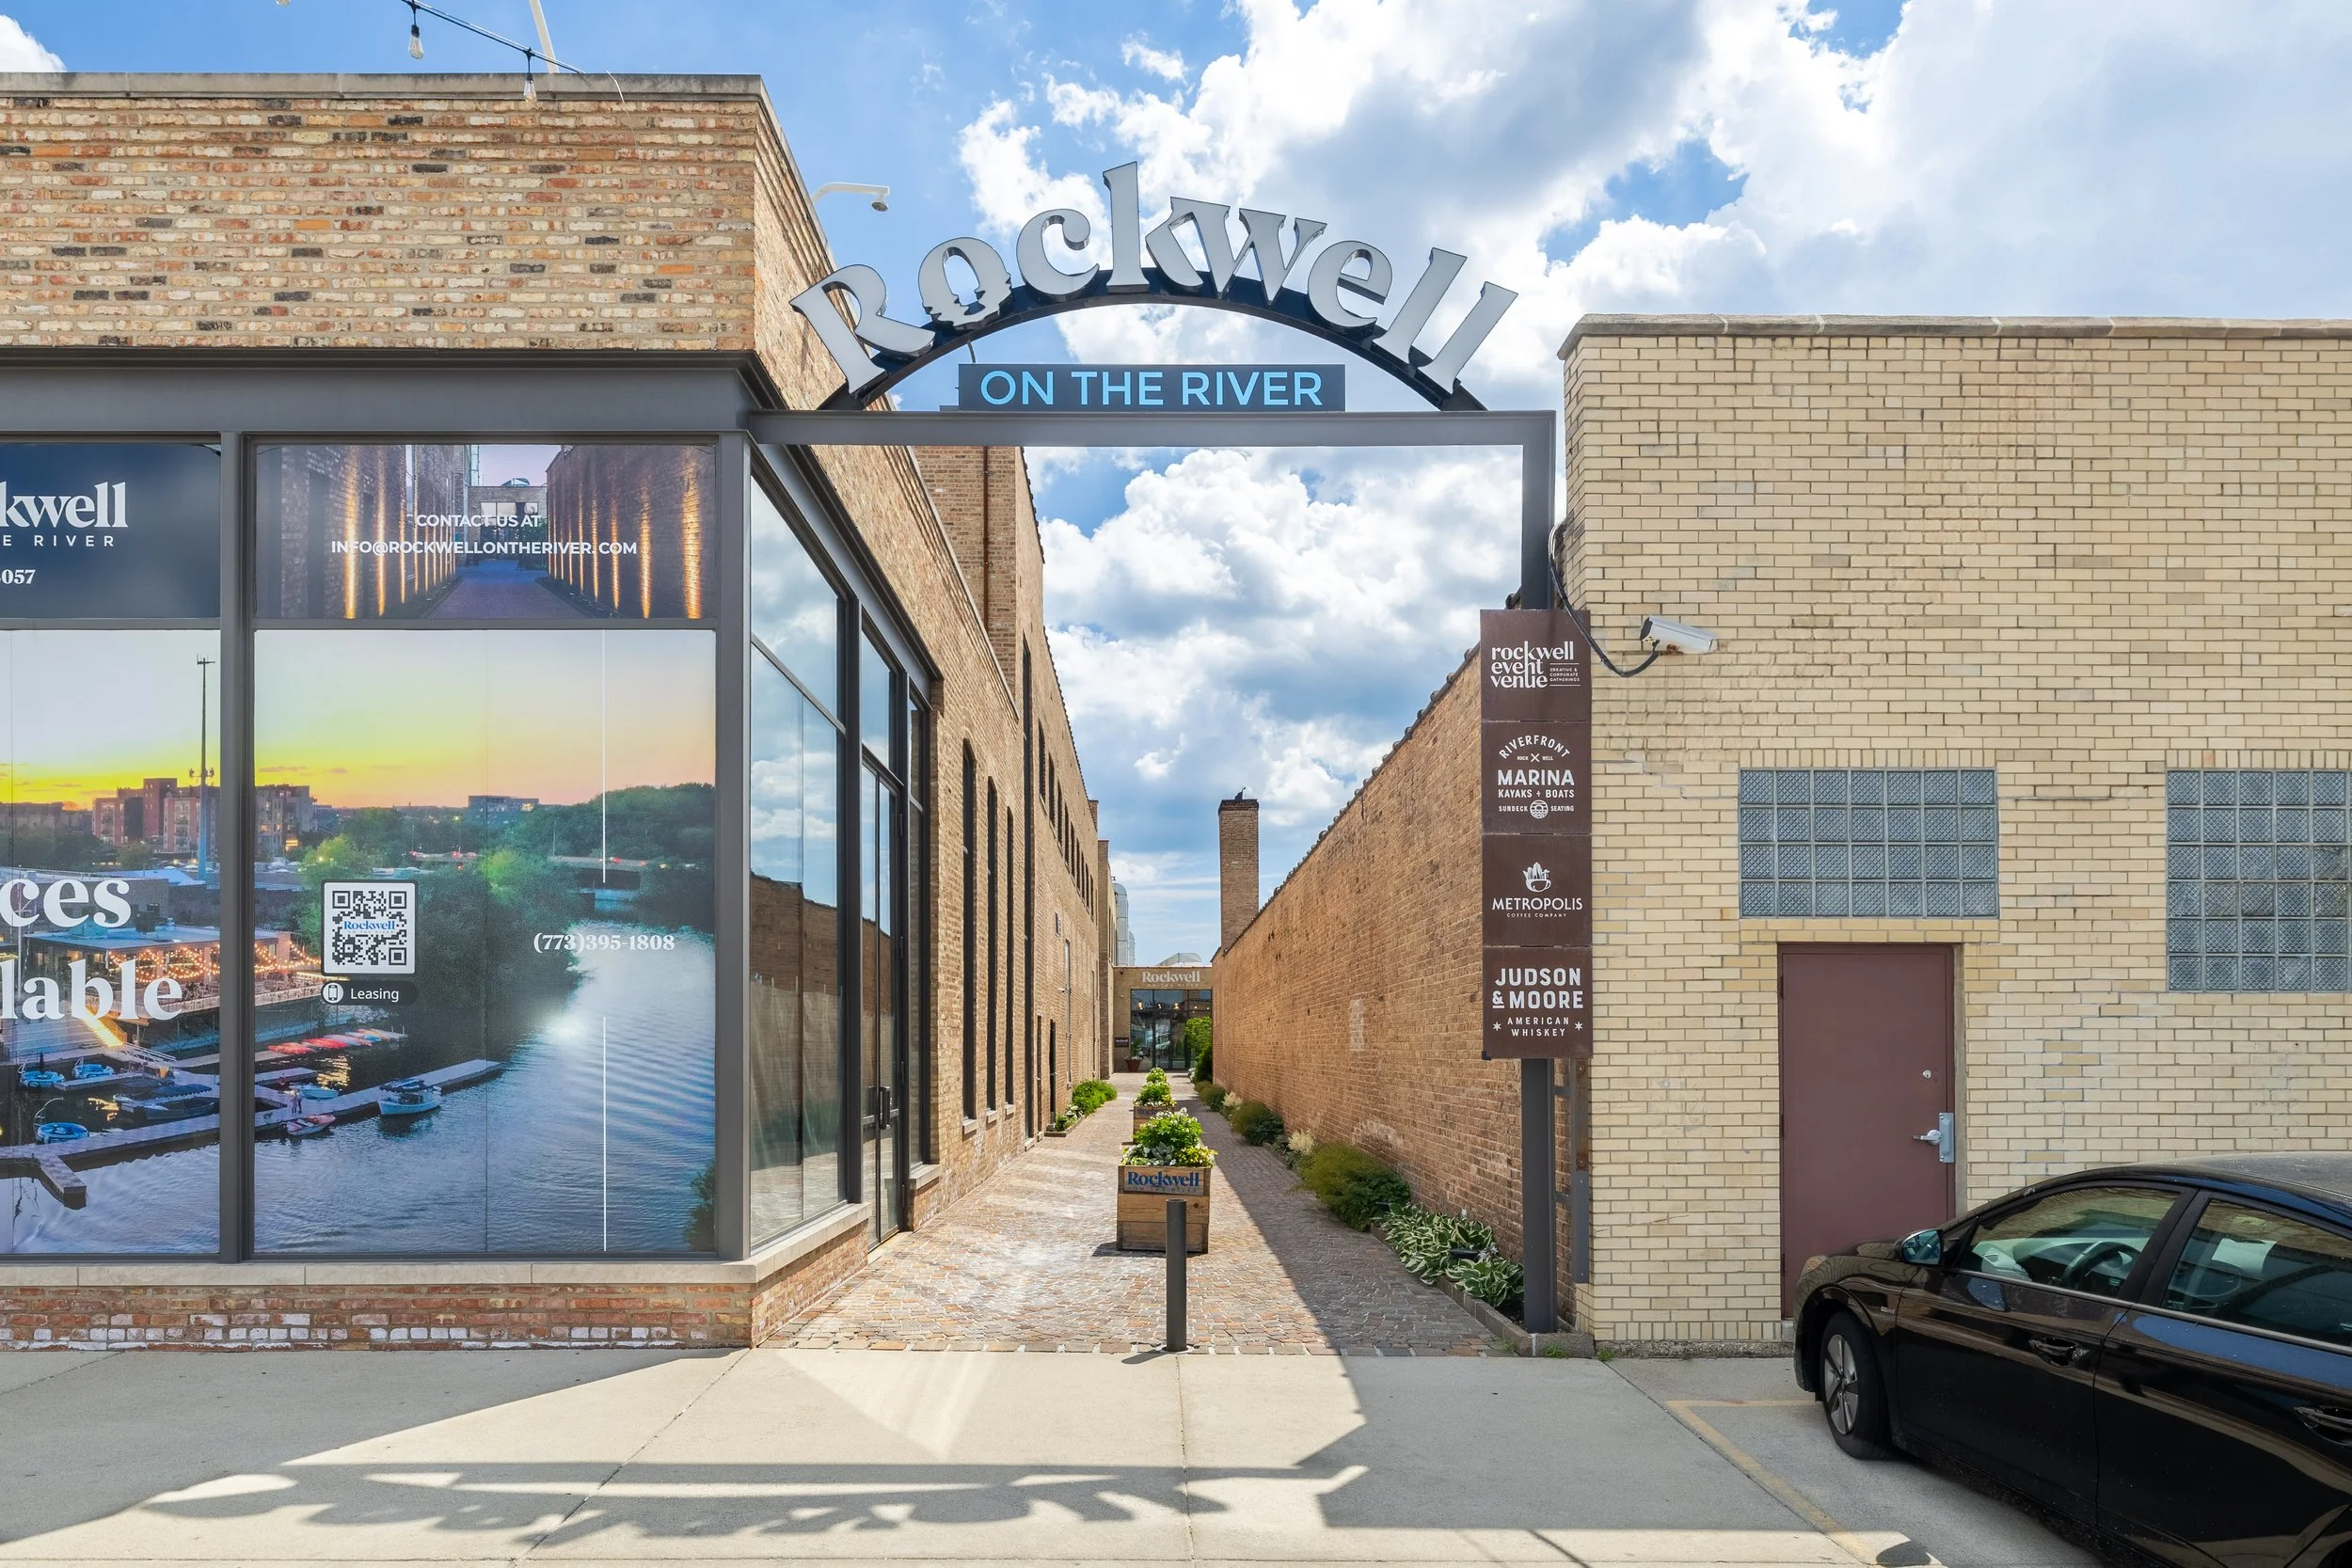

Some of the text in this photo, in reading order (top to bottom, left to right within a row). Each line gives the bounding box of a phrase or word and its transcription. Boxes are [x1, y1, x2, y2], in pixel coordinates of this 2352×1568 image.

[789, 161, 1518, 403] Rockwell
[979, 370, 1323, 406] ON THE RIVER
[417, 514, 542, 528] CONTACT US AT
[34, 534, 115, 547] RIVER
[1491, 641, 1574, 660] rockwell
[1491, 658, 1544, 675] event
[1490, 673, 1549, 689] venue
[1498, 735, 1570, 760] RIVERFRONT
[1498, 769, 1575, 786] MARINA
[1498, 789, 1533, 799] KAYAKS
[1546, 789, 1575, 799] BOATS
[0, 879, 131, 927] ces
[1492, 897, 1583, 911] METROPOLIS
[343, 920, 395, 930] Rockwell
[533, 932, 675, 954] (773)395-1808
[1142, 970, 1200, 983] Rockwell
[1495, 968, 1581, 987] JUDSON
[0, 958, 183, 1021] lable
[350, 988, 400, 1003] Leasing
[1492, 990, 1583, 1009] & MOORE
[1507, 1017, 1569, 1025] AMERICAN
[1511, 1028, 1565, 1037] WHISKEY
[1127, 1171, 1200, 1187] Rockwell
